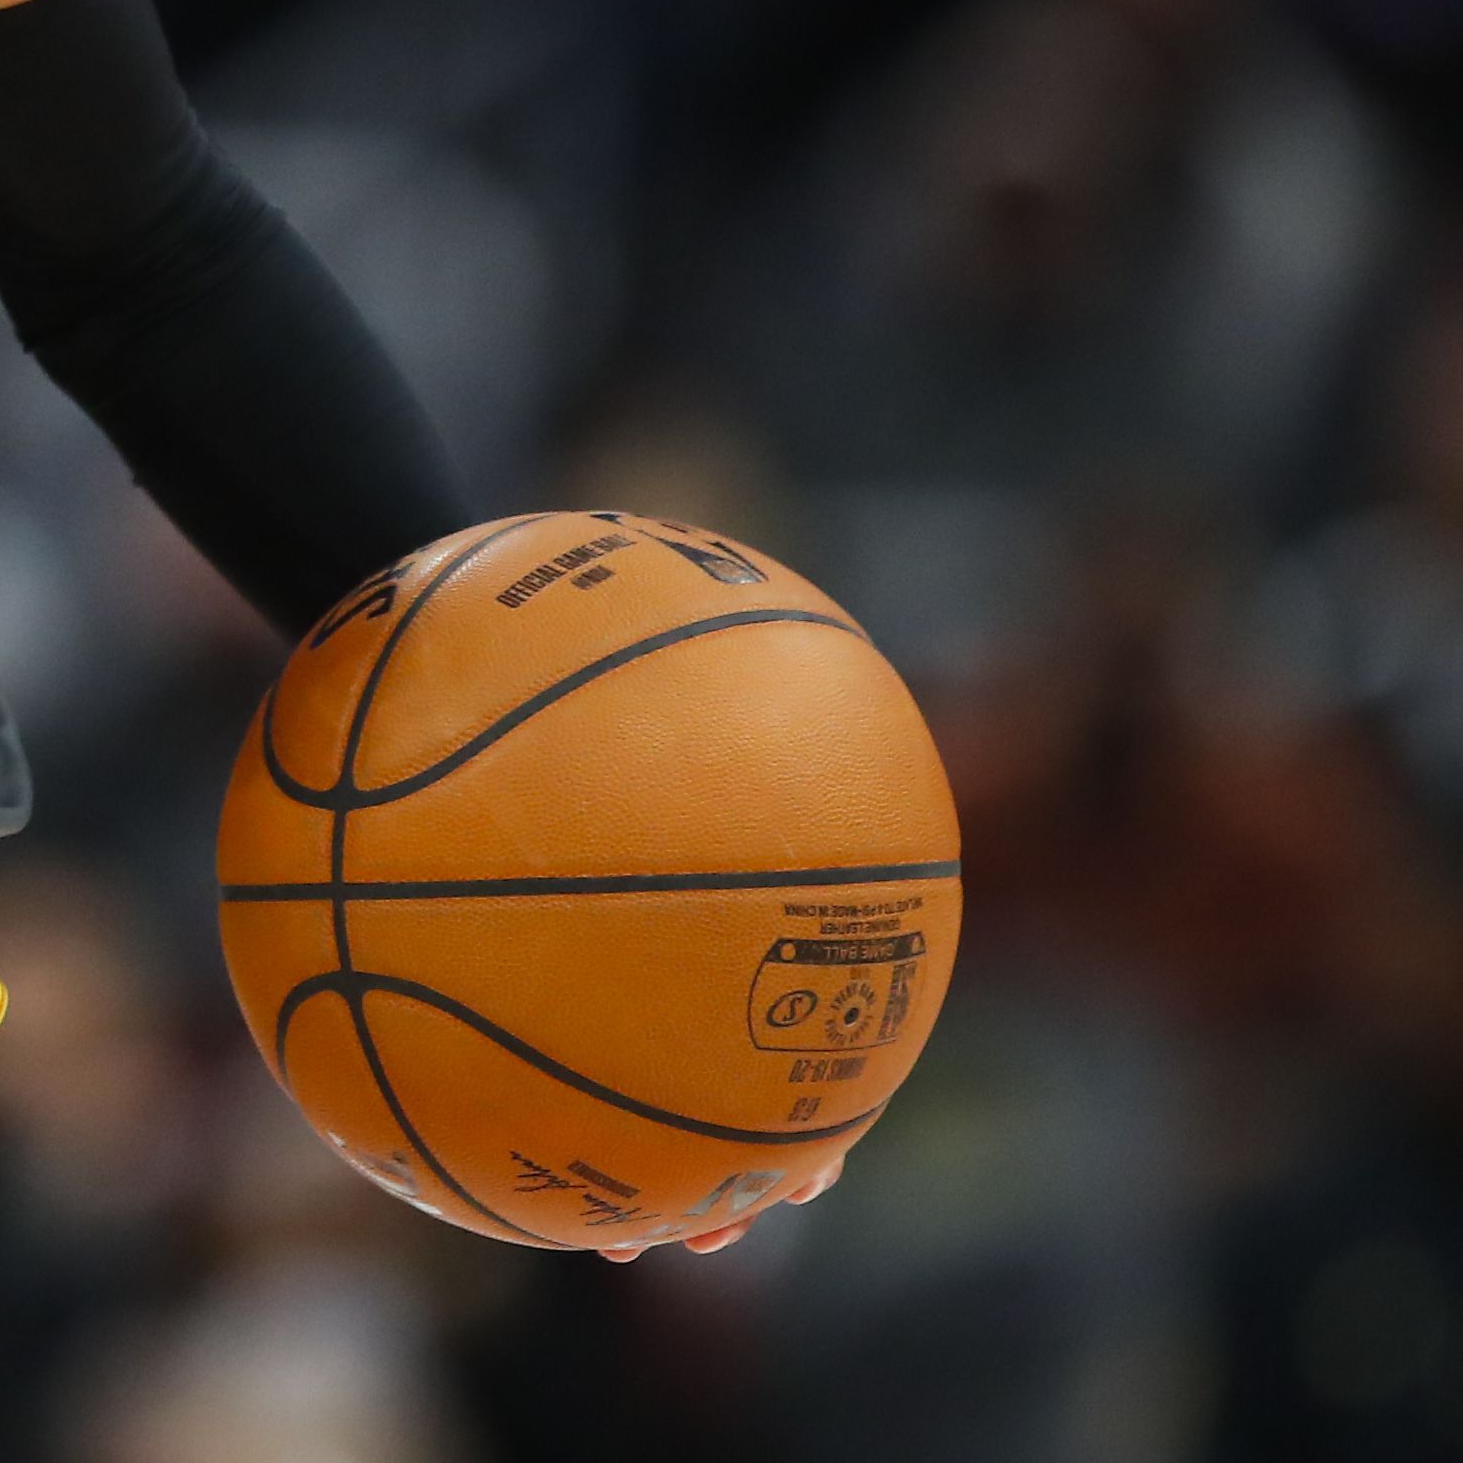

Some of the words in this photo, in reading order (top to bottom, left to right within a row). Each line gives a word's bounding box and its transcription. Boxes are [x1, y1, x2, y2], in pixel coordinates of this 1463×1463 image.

[495, 563, 567, 609] OFFICIAL
[552, 543, 605, 571] GAME
[784, 903, 817, 917] CHINA
[819, 920, 862, 935] LEATHER
[823, 945, 857, 960] BALL
